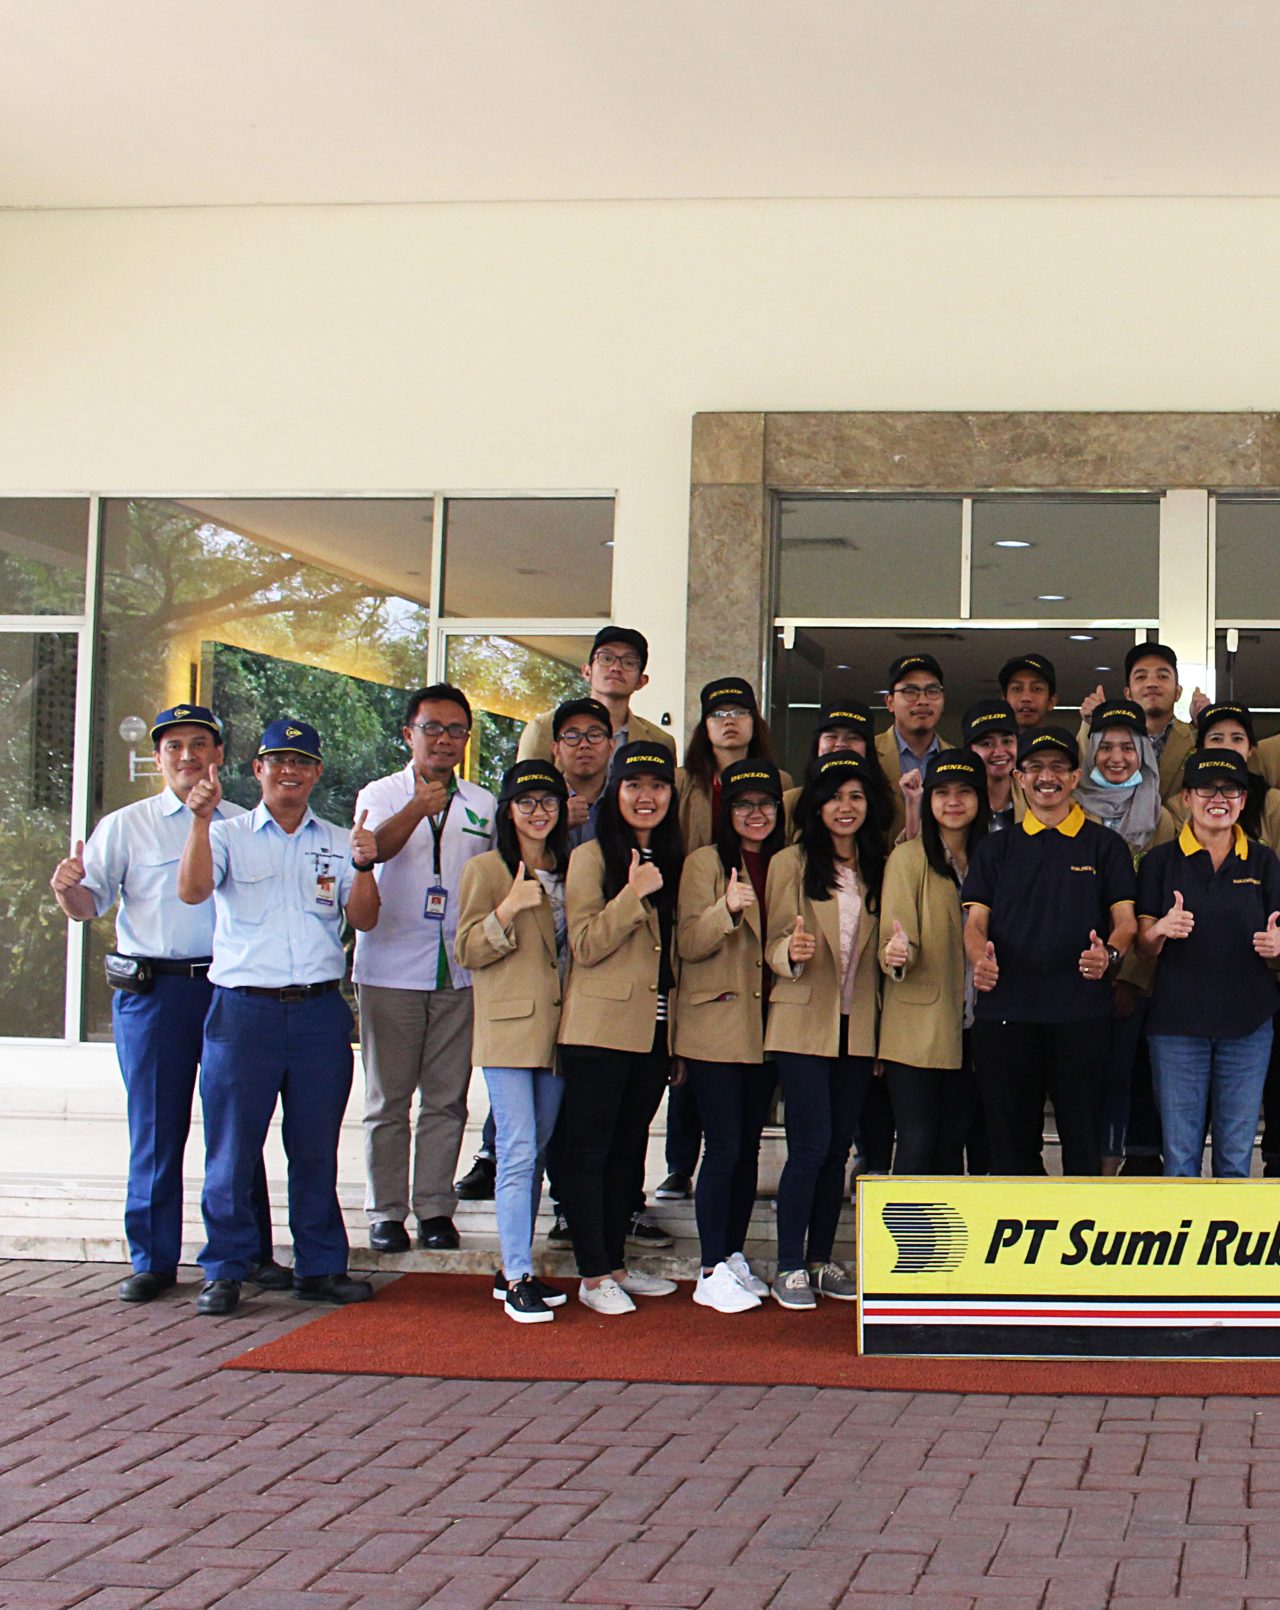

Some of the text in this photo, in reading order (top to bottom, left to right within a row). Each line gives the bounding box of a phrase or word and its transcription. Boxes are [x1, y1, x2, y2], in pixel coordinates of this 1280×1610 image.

[709, 688, 743, 700] DUNLOP
[829, 711, 866, 723] DUNLOP
[1102, 709, 1138, 719] DUNLOP
[971, 713, 1007, 728] DUNLOP
[626, 755, 665, 765] DUNLOP
[821, 759, 859, 773] DUNLOP
[1198, 760, 1238, 771] DUNLOP
[936, 763, 975, 774] DUNLOP
[730, 771, 770, 783] DUNLOP
[984, 1219, 1060, 1265] PT
[1060, 1219, 1193, 1266] Sumi
